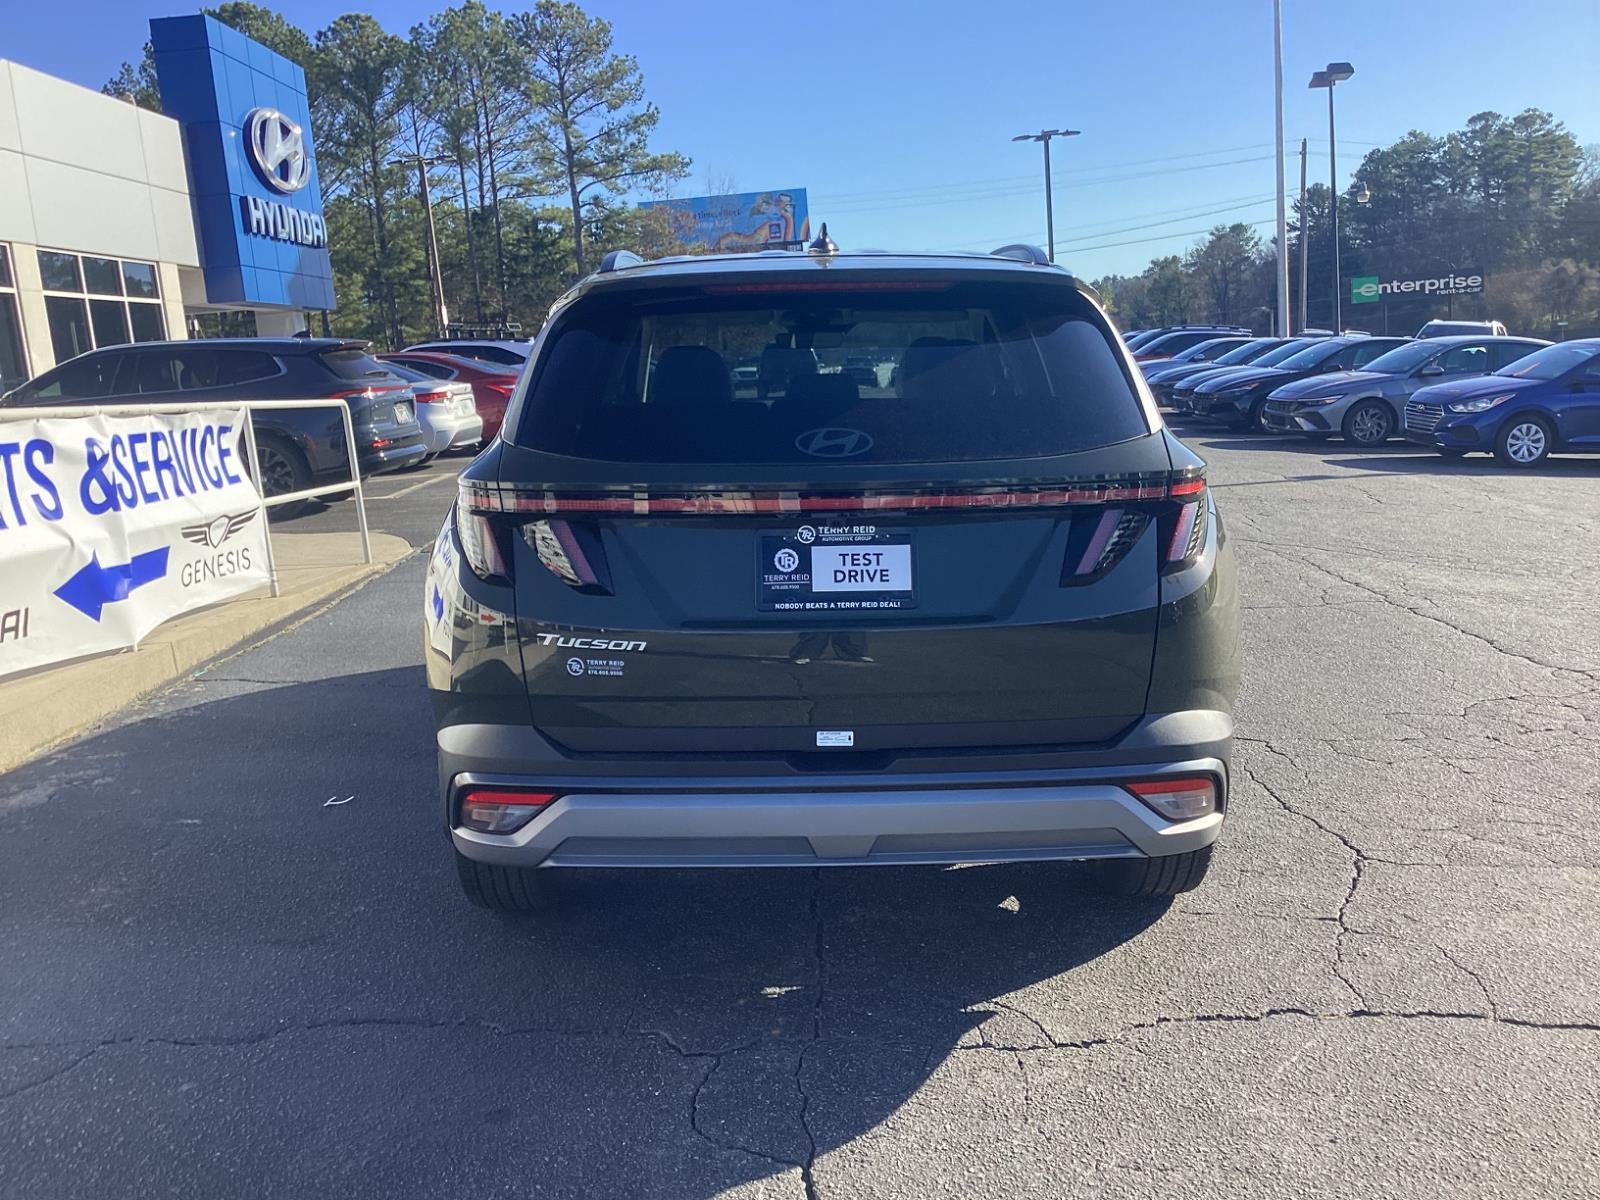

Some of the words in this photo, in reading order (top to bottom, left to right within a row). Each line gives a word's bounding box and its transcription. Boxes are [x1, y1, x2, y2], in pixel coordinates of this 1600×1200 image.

[245, 195, 328, 247] HYUNDAI
[1353, 274, 1482, 297] enterprise
[1437, 286, 1482, 296] rent-a-car
[0, 439, 64, 530] TS
[818, 526, 849, 534] TERRY
[853, 525, 876, 533] REID
[181, 548, 251, 587] GENESIS
[838, 553, 883, 567] TEST
[834, 569, 890, 583] DRIVE
